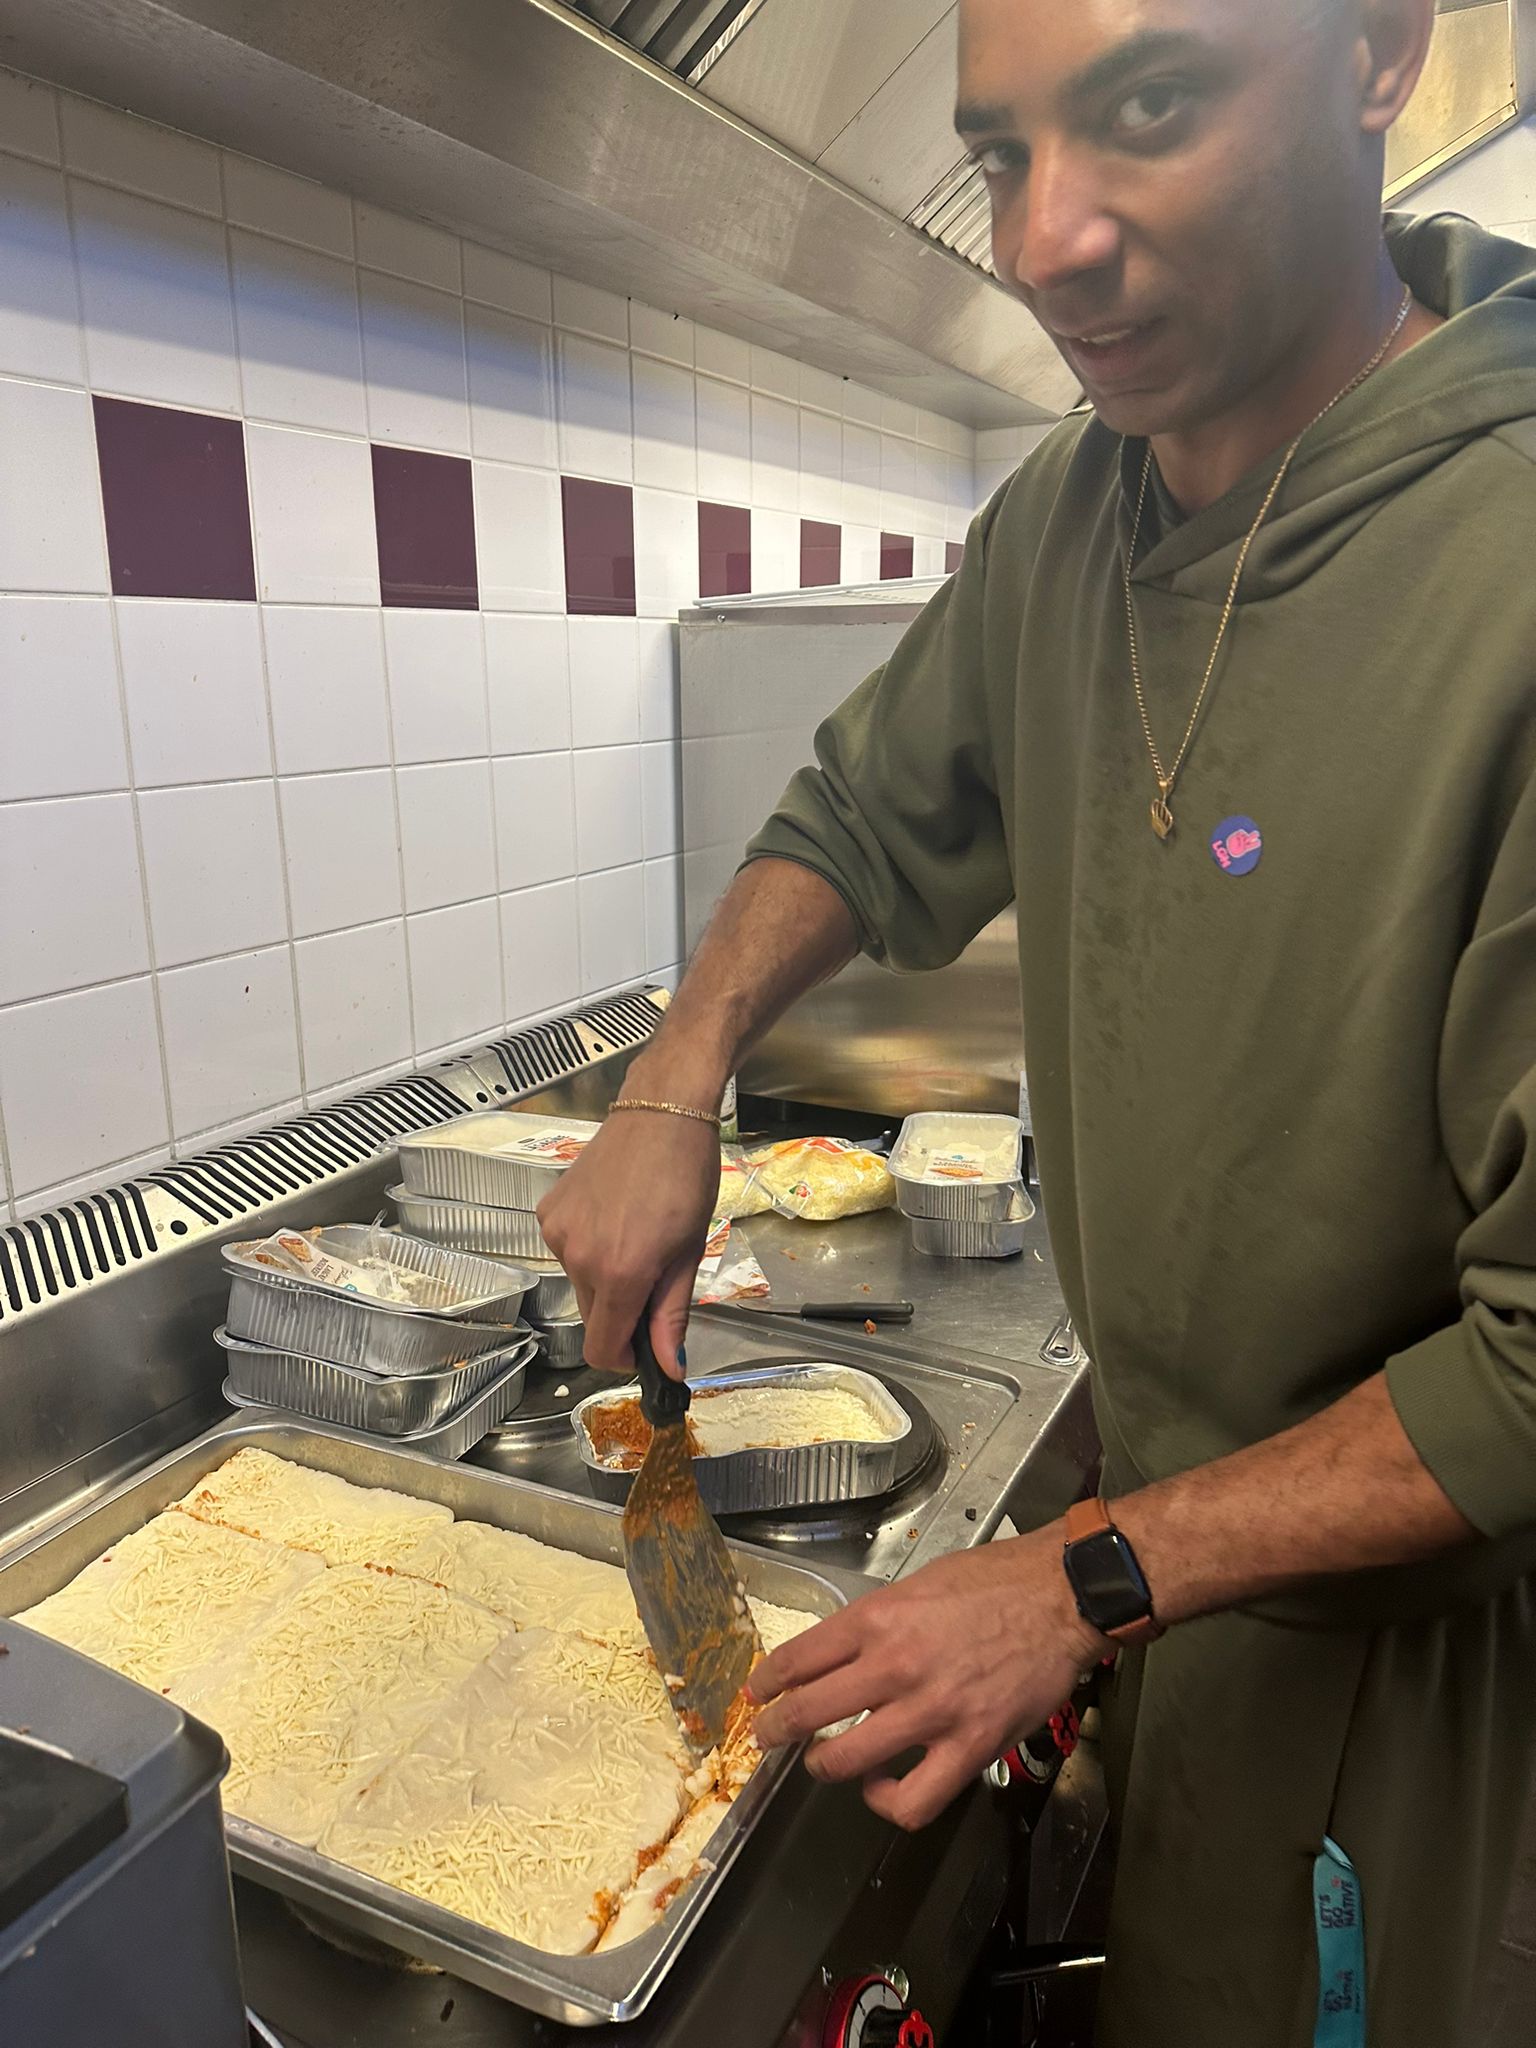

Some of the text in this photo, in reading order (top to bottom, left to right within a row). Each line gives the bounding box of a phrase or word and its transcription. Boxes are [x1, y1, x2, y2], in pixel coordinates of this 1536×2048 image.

[1319, 1894, 1333, 1928] LET'S
[1332, 1907, 1344, 1928] GO
[1342, 1880, 1355, 1927] NATIVE
